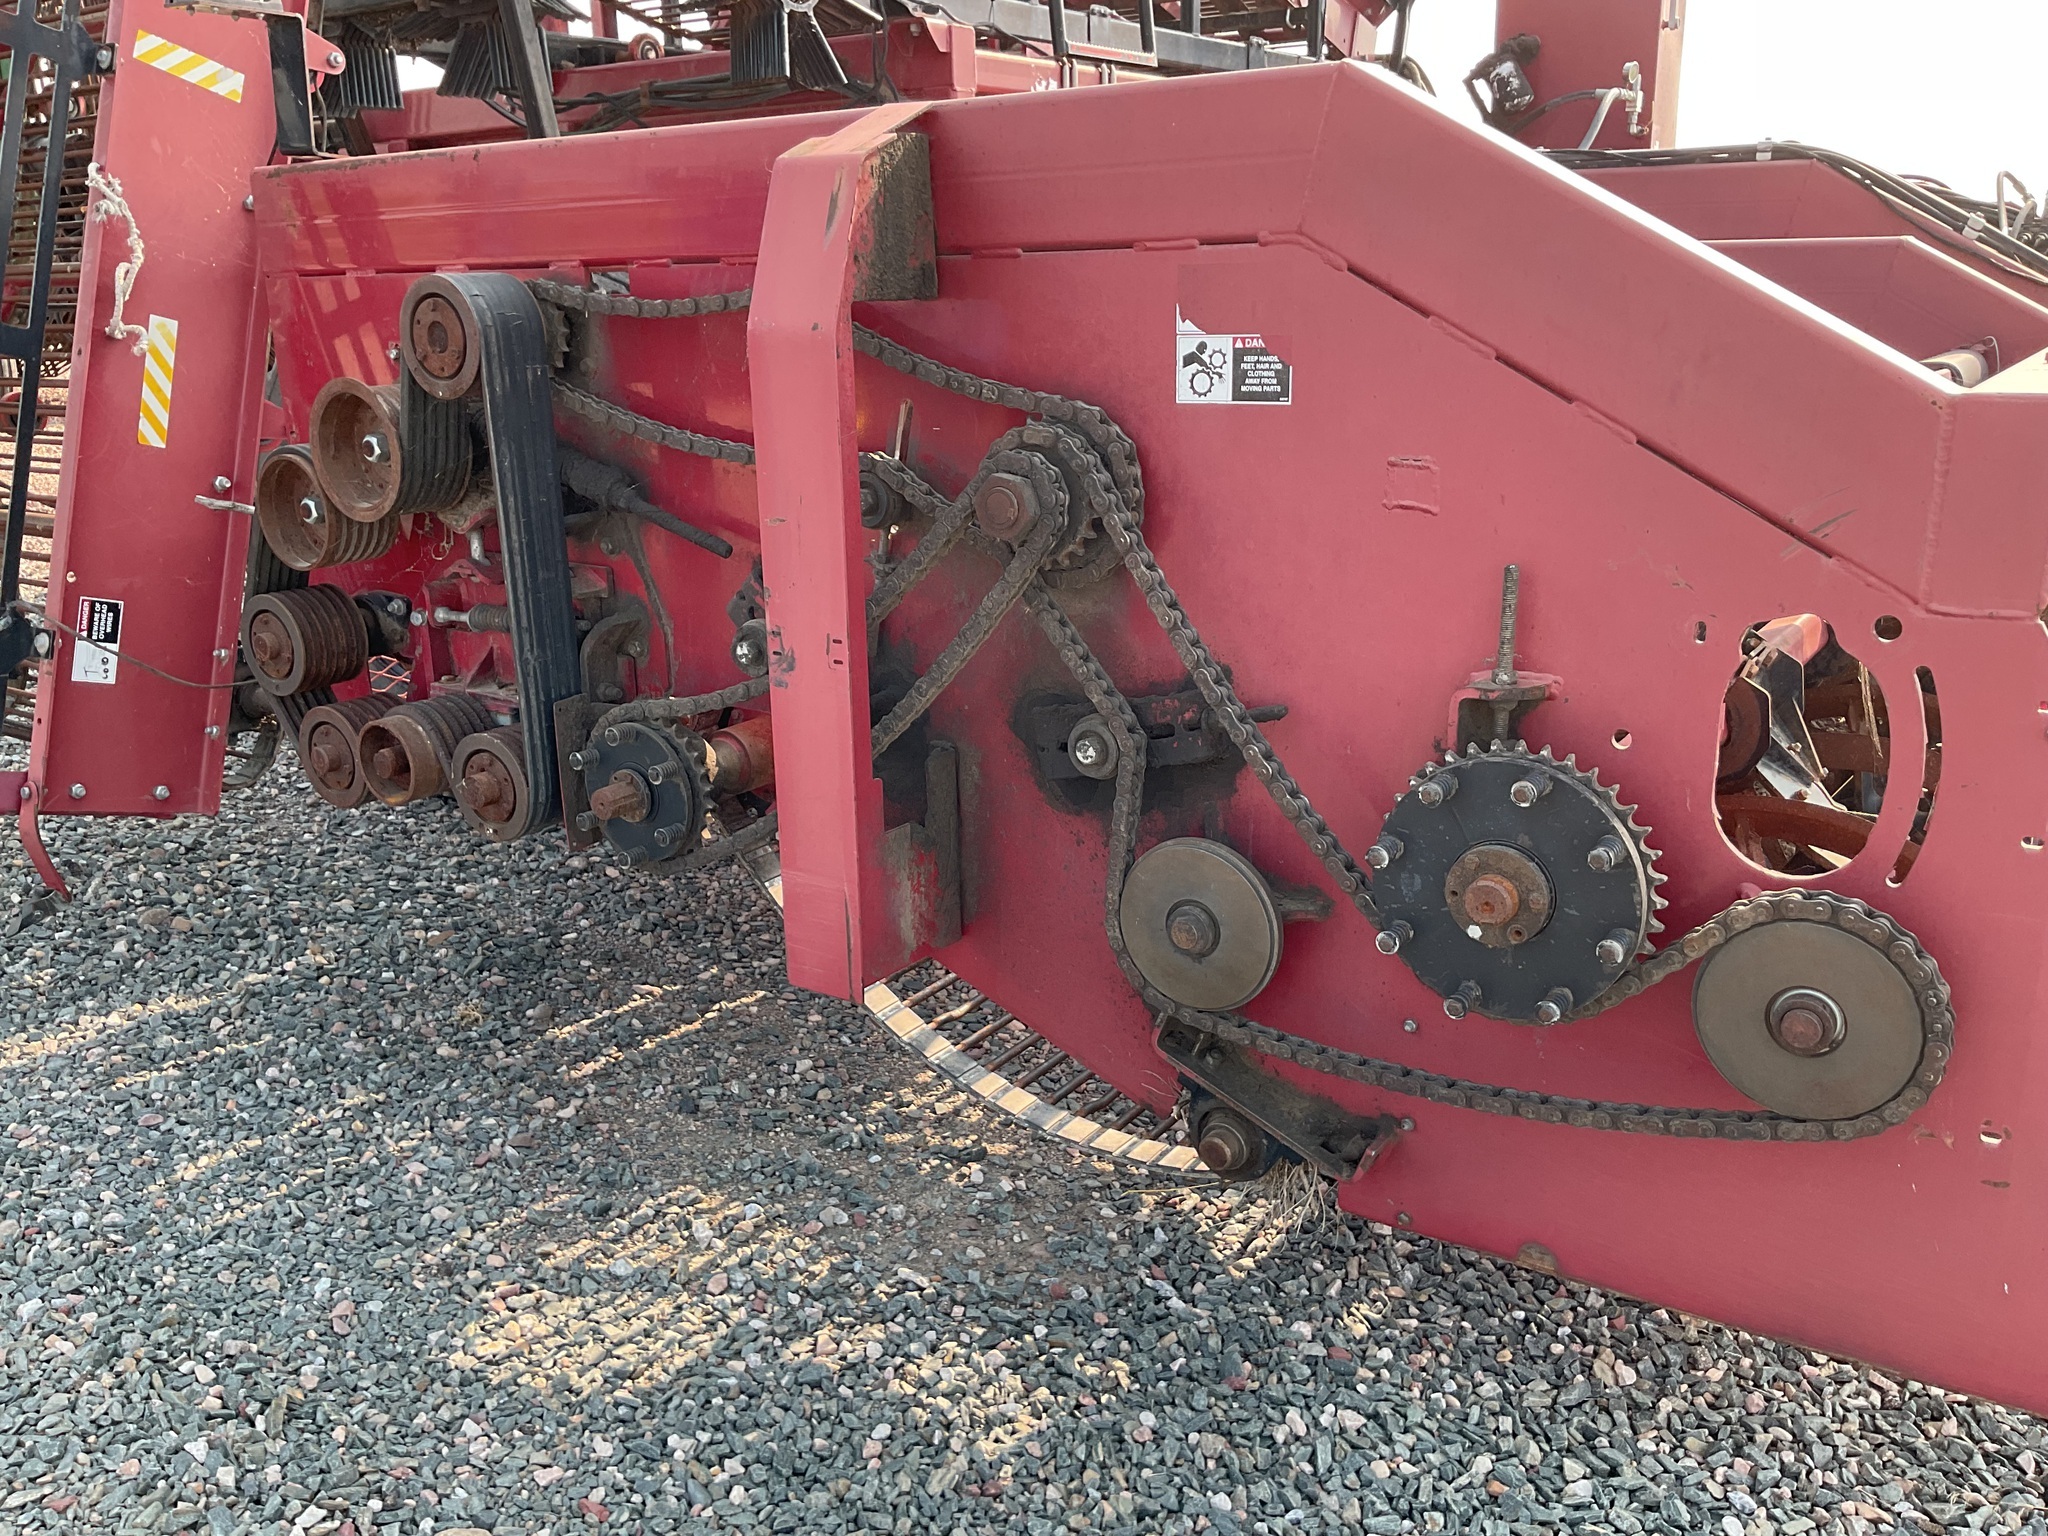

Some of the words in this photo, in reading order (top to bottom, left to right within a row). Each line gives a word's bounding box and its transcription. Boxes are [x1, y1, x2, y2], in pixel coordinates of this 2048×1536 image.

[81, 601, 90, 630] DANGER
[95, 602, 101, 612] OF
[92, 612, 100, 640] BEWARE
[99, 604, 108, 640] OVERHEAD
[106, 612, 114, 633] WIRES
